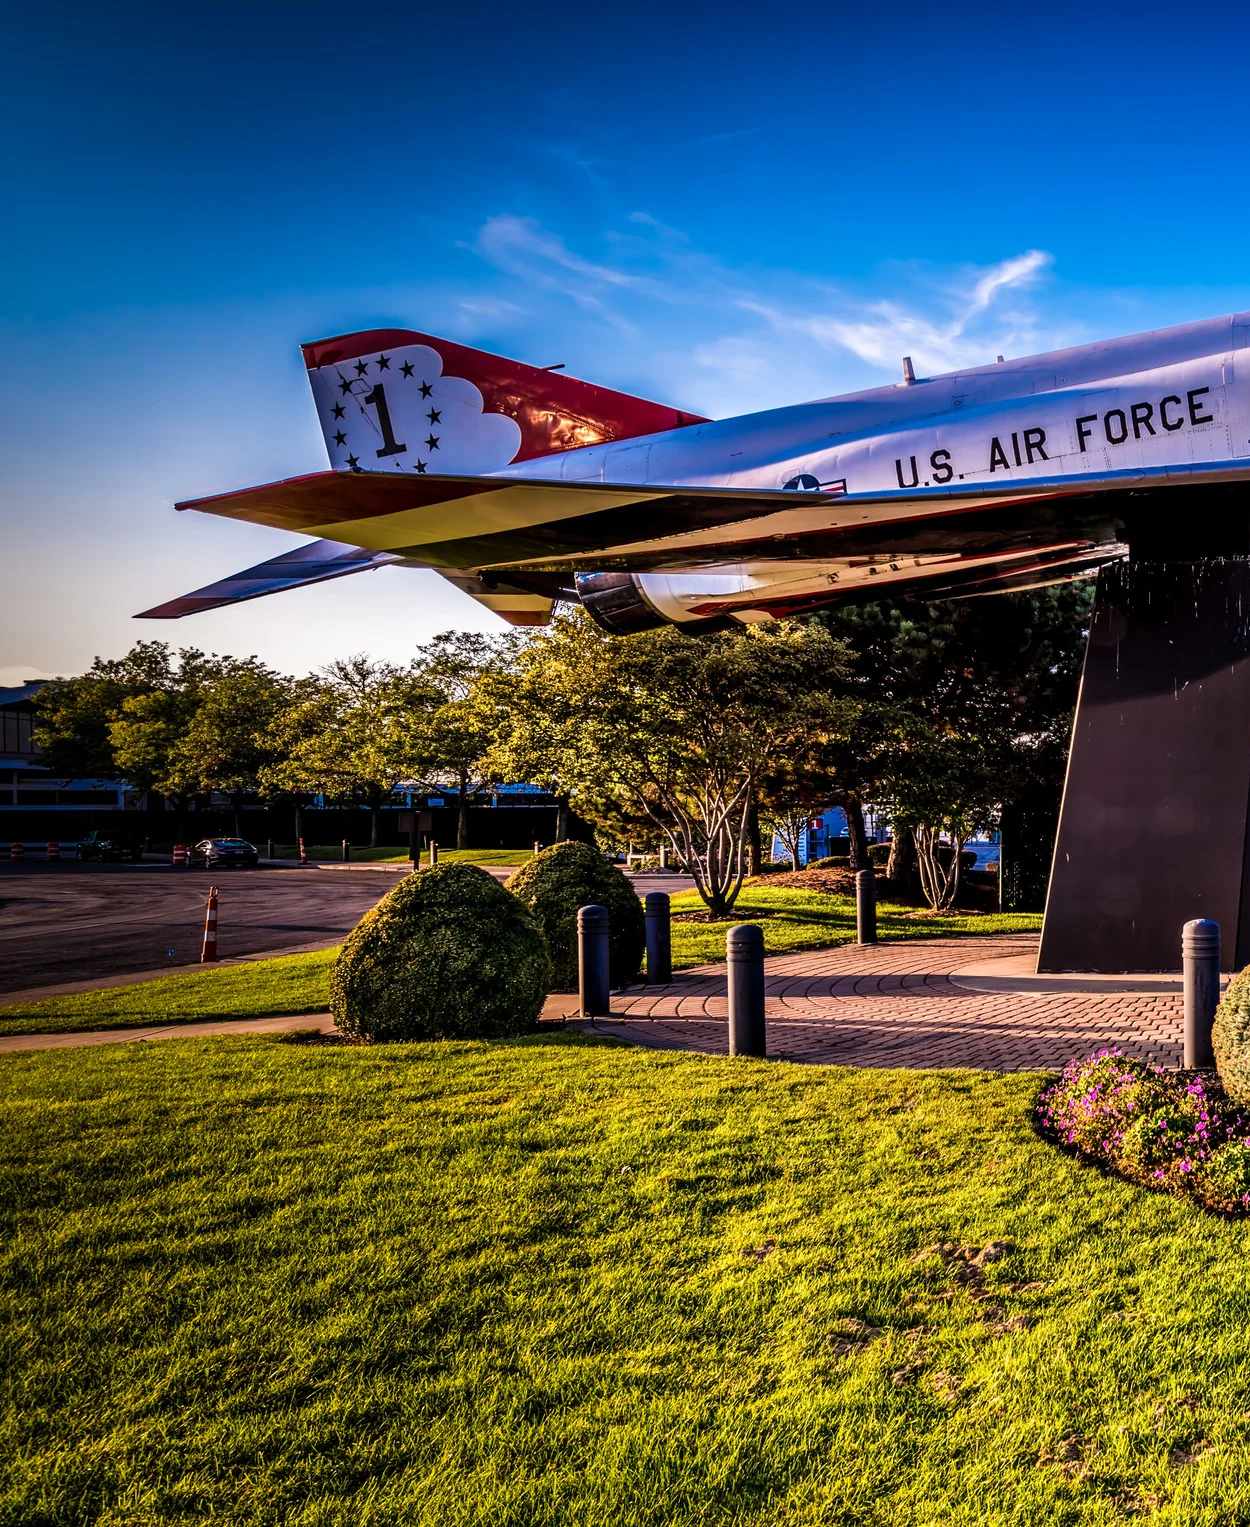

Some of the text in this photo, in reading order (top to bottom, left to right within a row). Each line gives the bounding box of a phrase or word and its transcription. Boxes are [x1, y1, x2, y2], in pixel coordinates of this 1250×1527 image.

[364, 383, 407, 458] 1
[895, 387, 1213, 489] U.S. AIR FORCE
[811, 820, 819, 830] 1
